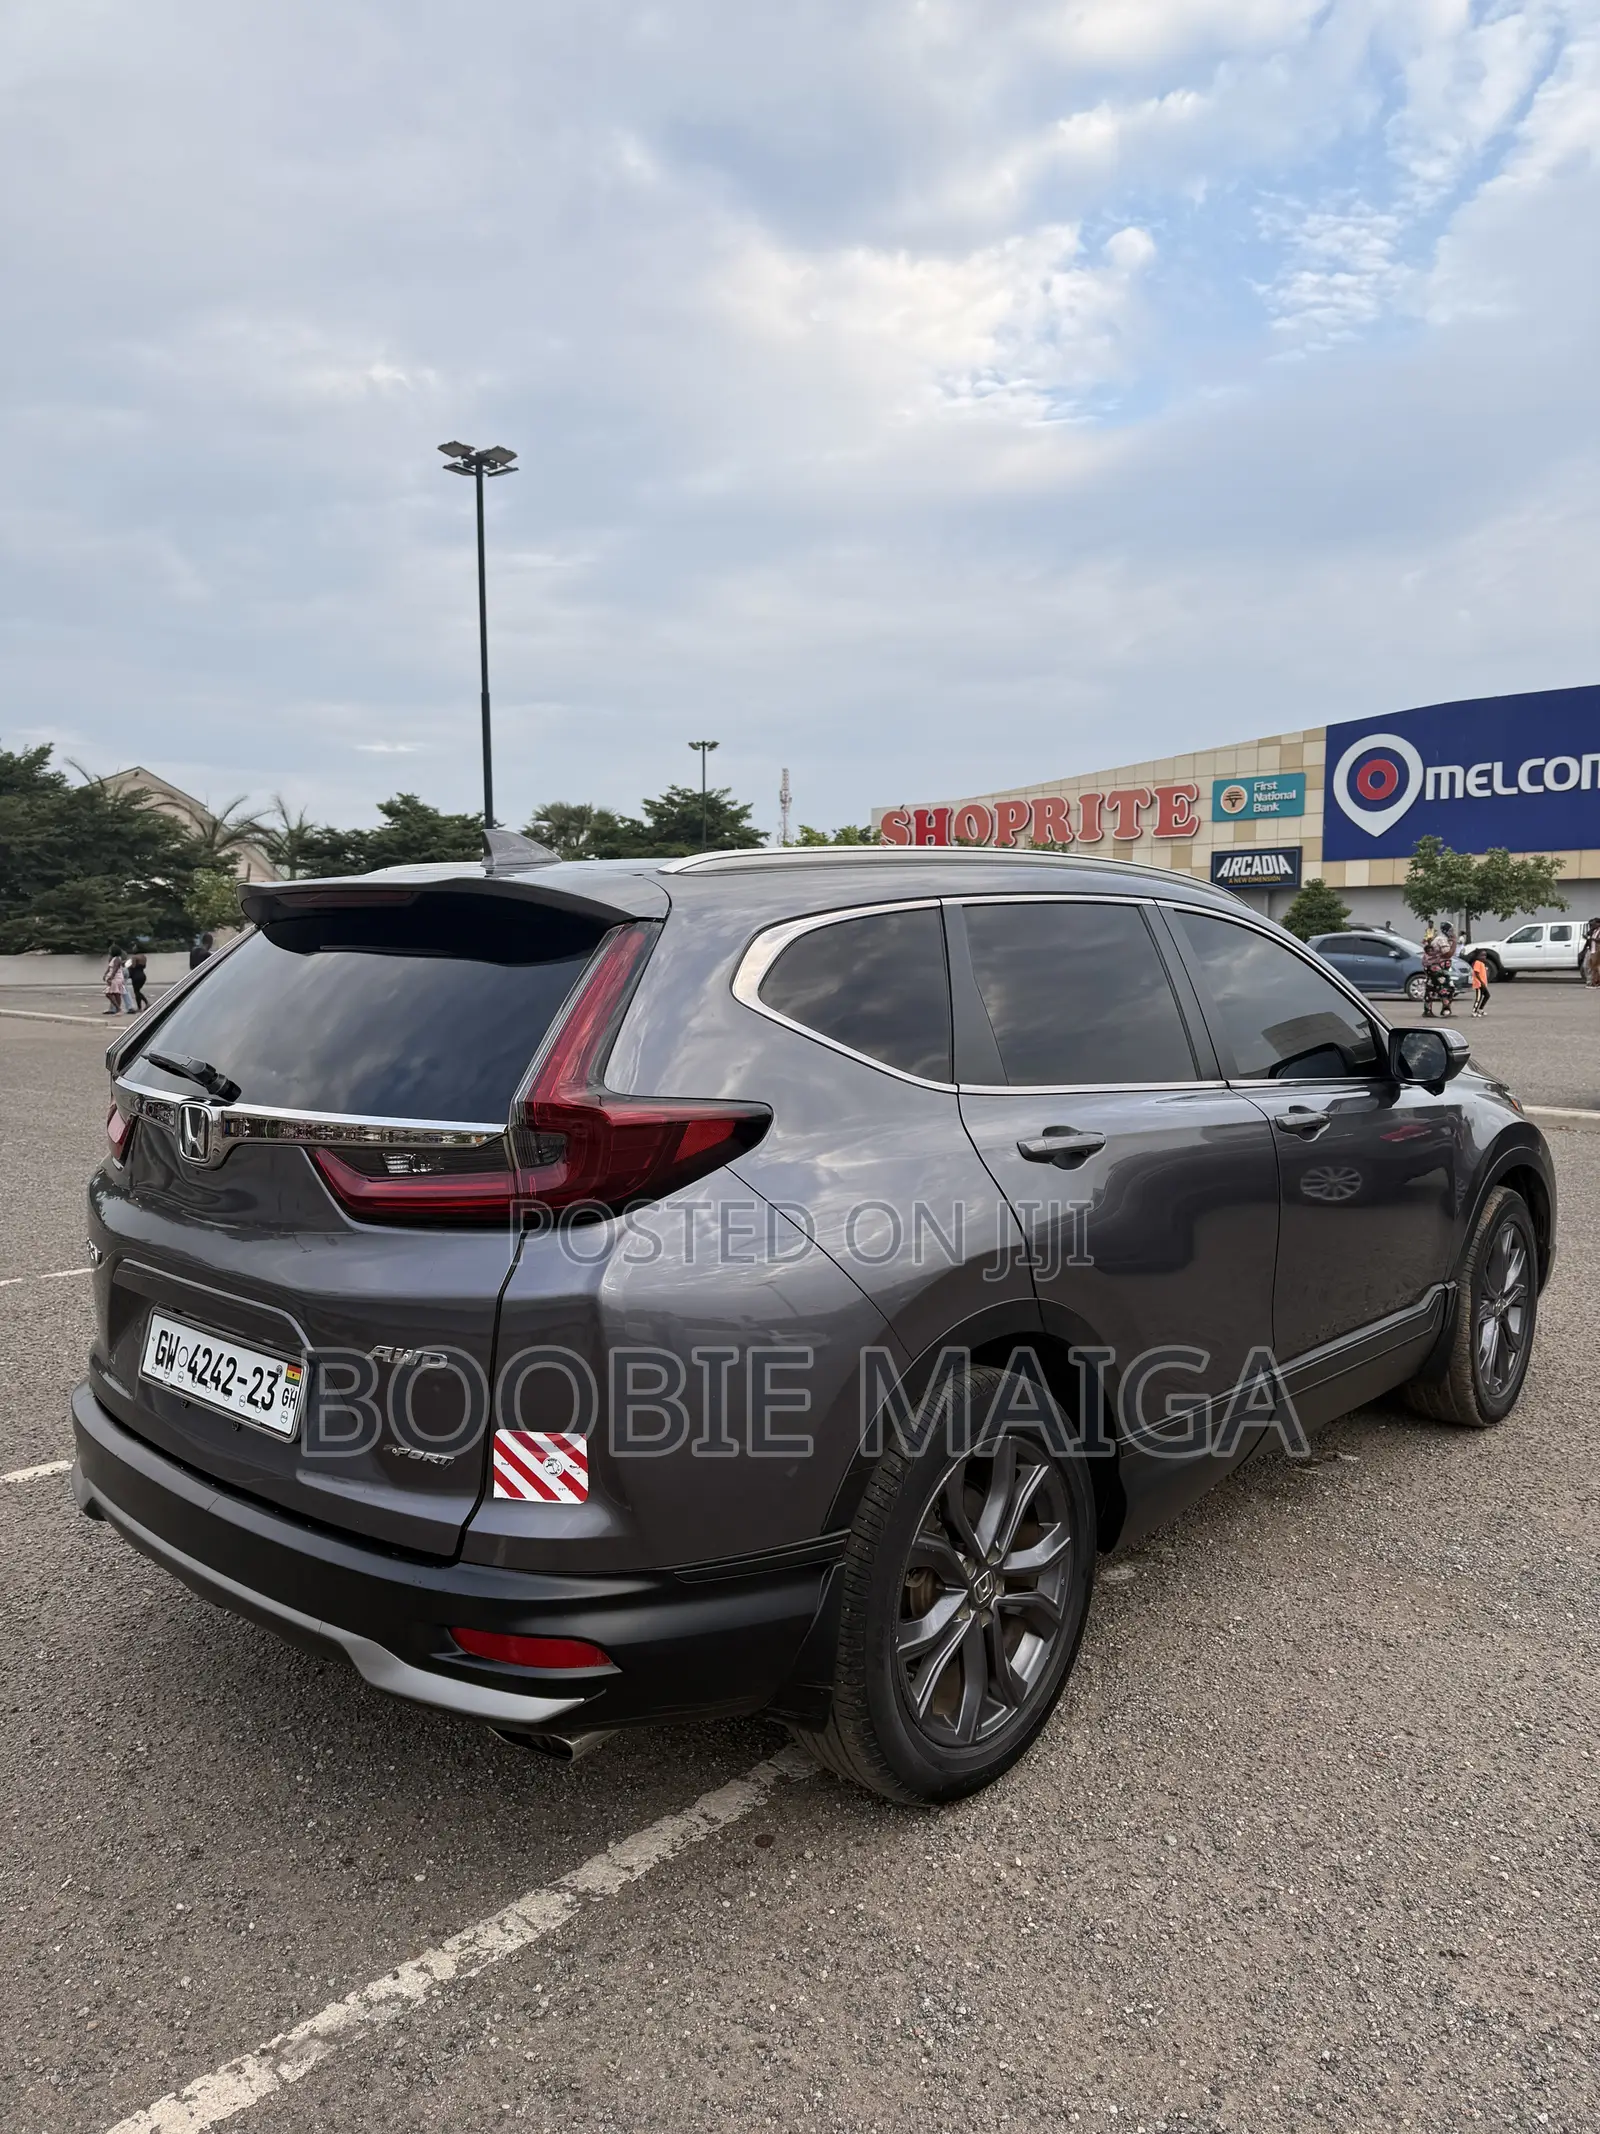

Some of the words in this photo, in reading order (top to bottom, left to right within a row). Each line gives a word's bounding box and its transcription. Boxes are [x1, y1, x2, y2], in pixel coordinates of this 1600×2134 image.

[1253, 781, 1278, 791] First
[1253, 790, 1297, 802] National
[880, 782, 1200, 847] SHOPRITE
[1253, 802, 1280, 813] Bank
[1216, 854, 1294, 879] ARCADIA
[1248, 875, 1281, 883] DIMENSION
[365, 1345, 448, 1369] AWD
[155, 1330, 181, 1372] GW
[187, 1344, 280, 1411] 4242-23
[281, 1387, 298, 1410] GH
